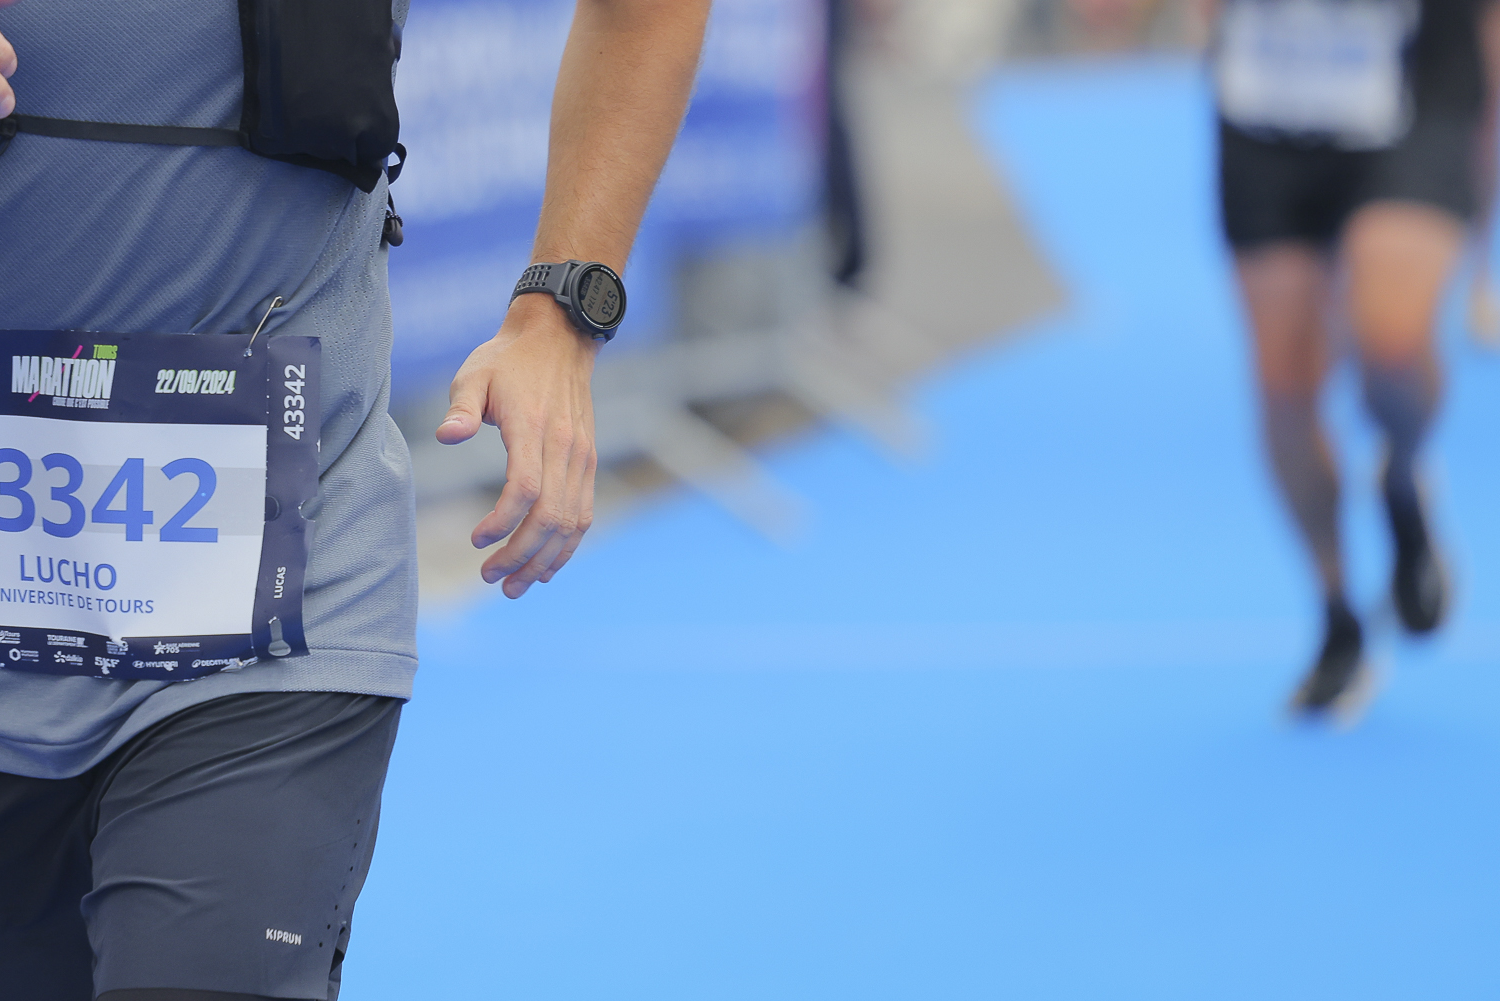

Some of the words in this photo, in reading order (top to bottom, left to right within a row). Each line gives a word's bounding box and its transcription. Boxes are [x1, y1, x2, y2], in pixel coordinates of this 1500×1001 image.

[93, 344, 118, 360] TOURS
[11, 355, 117, 399] MARATHON
[155, 369, 237, 395] 22/09/2024
[283, 364, 306, 440] 43342
[19, 554, 118, 591] LUCHO
[274, 566, 287, 599] LUCAS
[77, 595, 94, 612] DE
[96, 598, 155, 614] TOURS
[265, 928, 302, 945] KIPRUN
